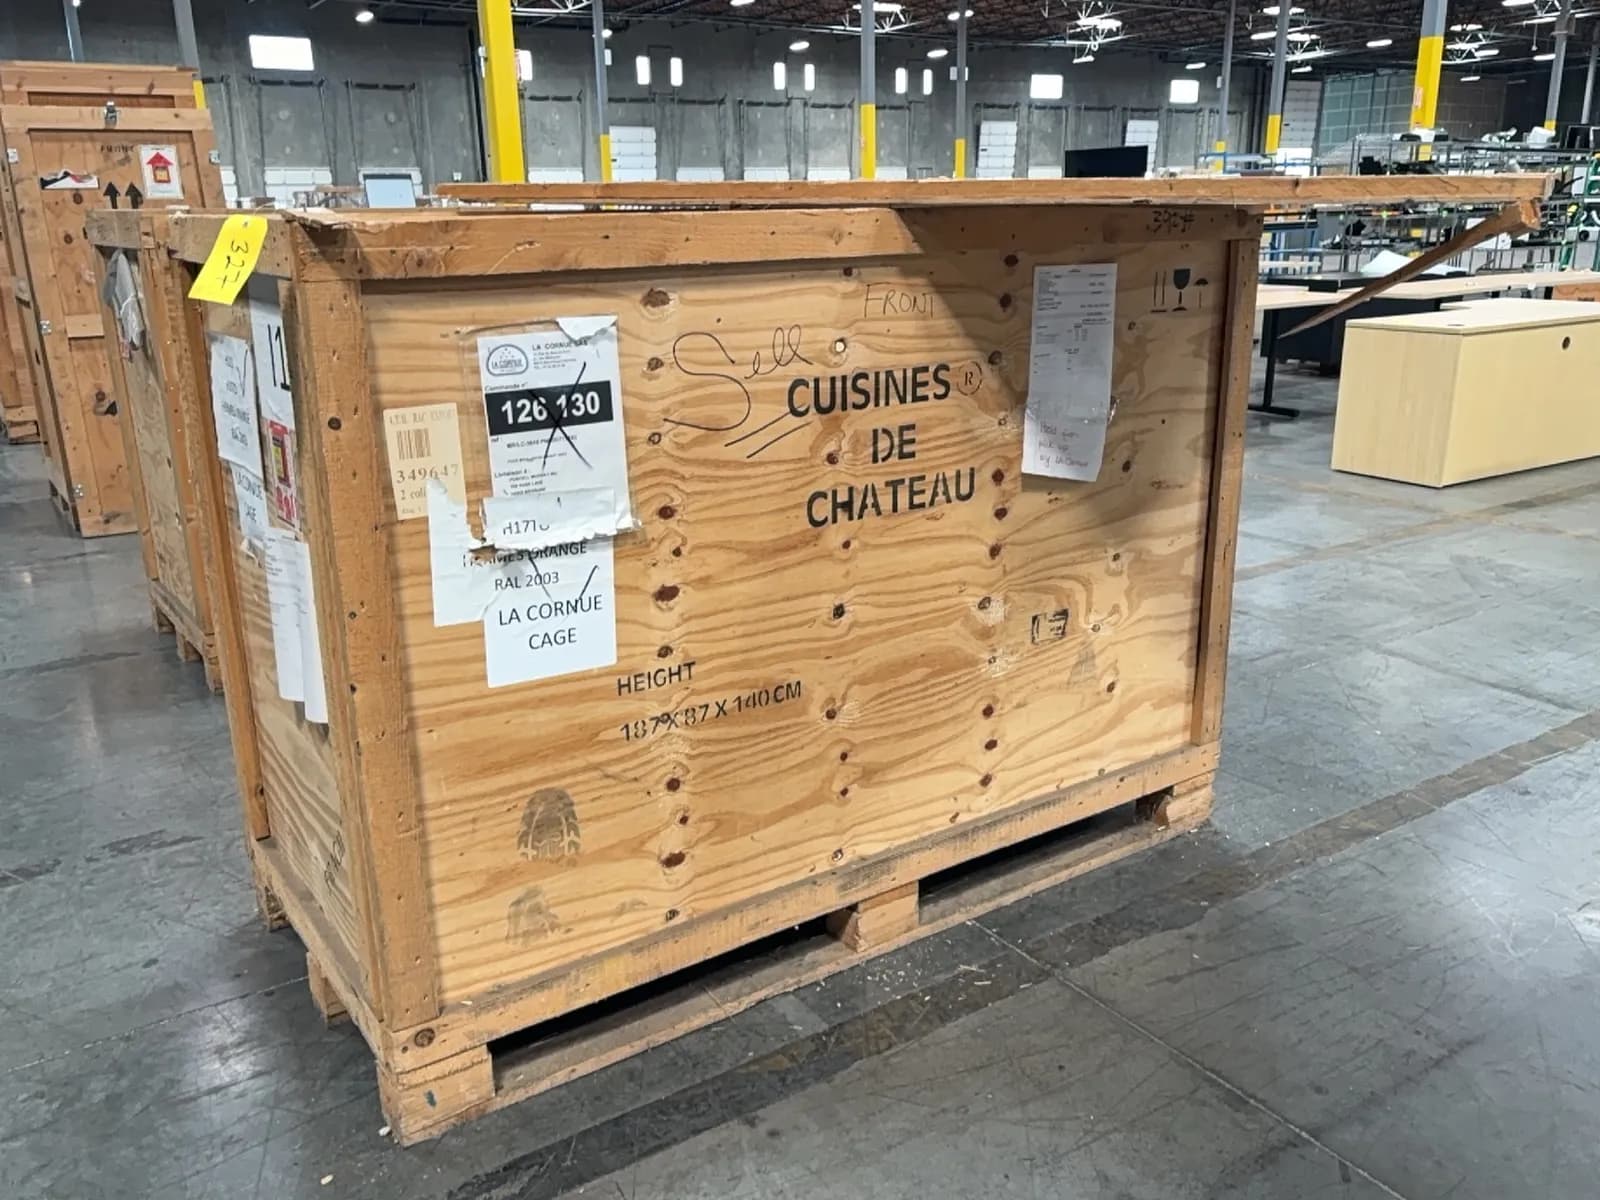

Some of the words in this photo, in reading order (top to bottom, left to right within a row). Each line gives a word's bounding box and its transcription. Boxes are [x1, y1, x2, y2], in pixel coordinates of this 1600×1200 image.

[215, 239, 249, 289] 327
[663, 324, 813, 431] Sell
[787, 364, 951, 418] CUISINES
[501, 398, 548, 425] 126
[556, 391, 600, 418] 130
[871, 424, 917, 464] DE
[807, 468, 976, 528] CHATEAU
[494, 575, 522, 592] RAL
[526, 571, 560, 586] 2003
[499, 609, 521, 626] LA
[526, 594, 603, 622] CORNUE
[528, 627, 577, 651] CAGE
[617, 661, 696, 696] HEIGHT
